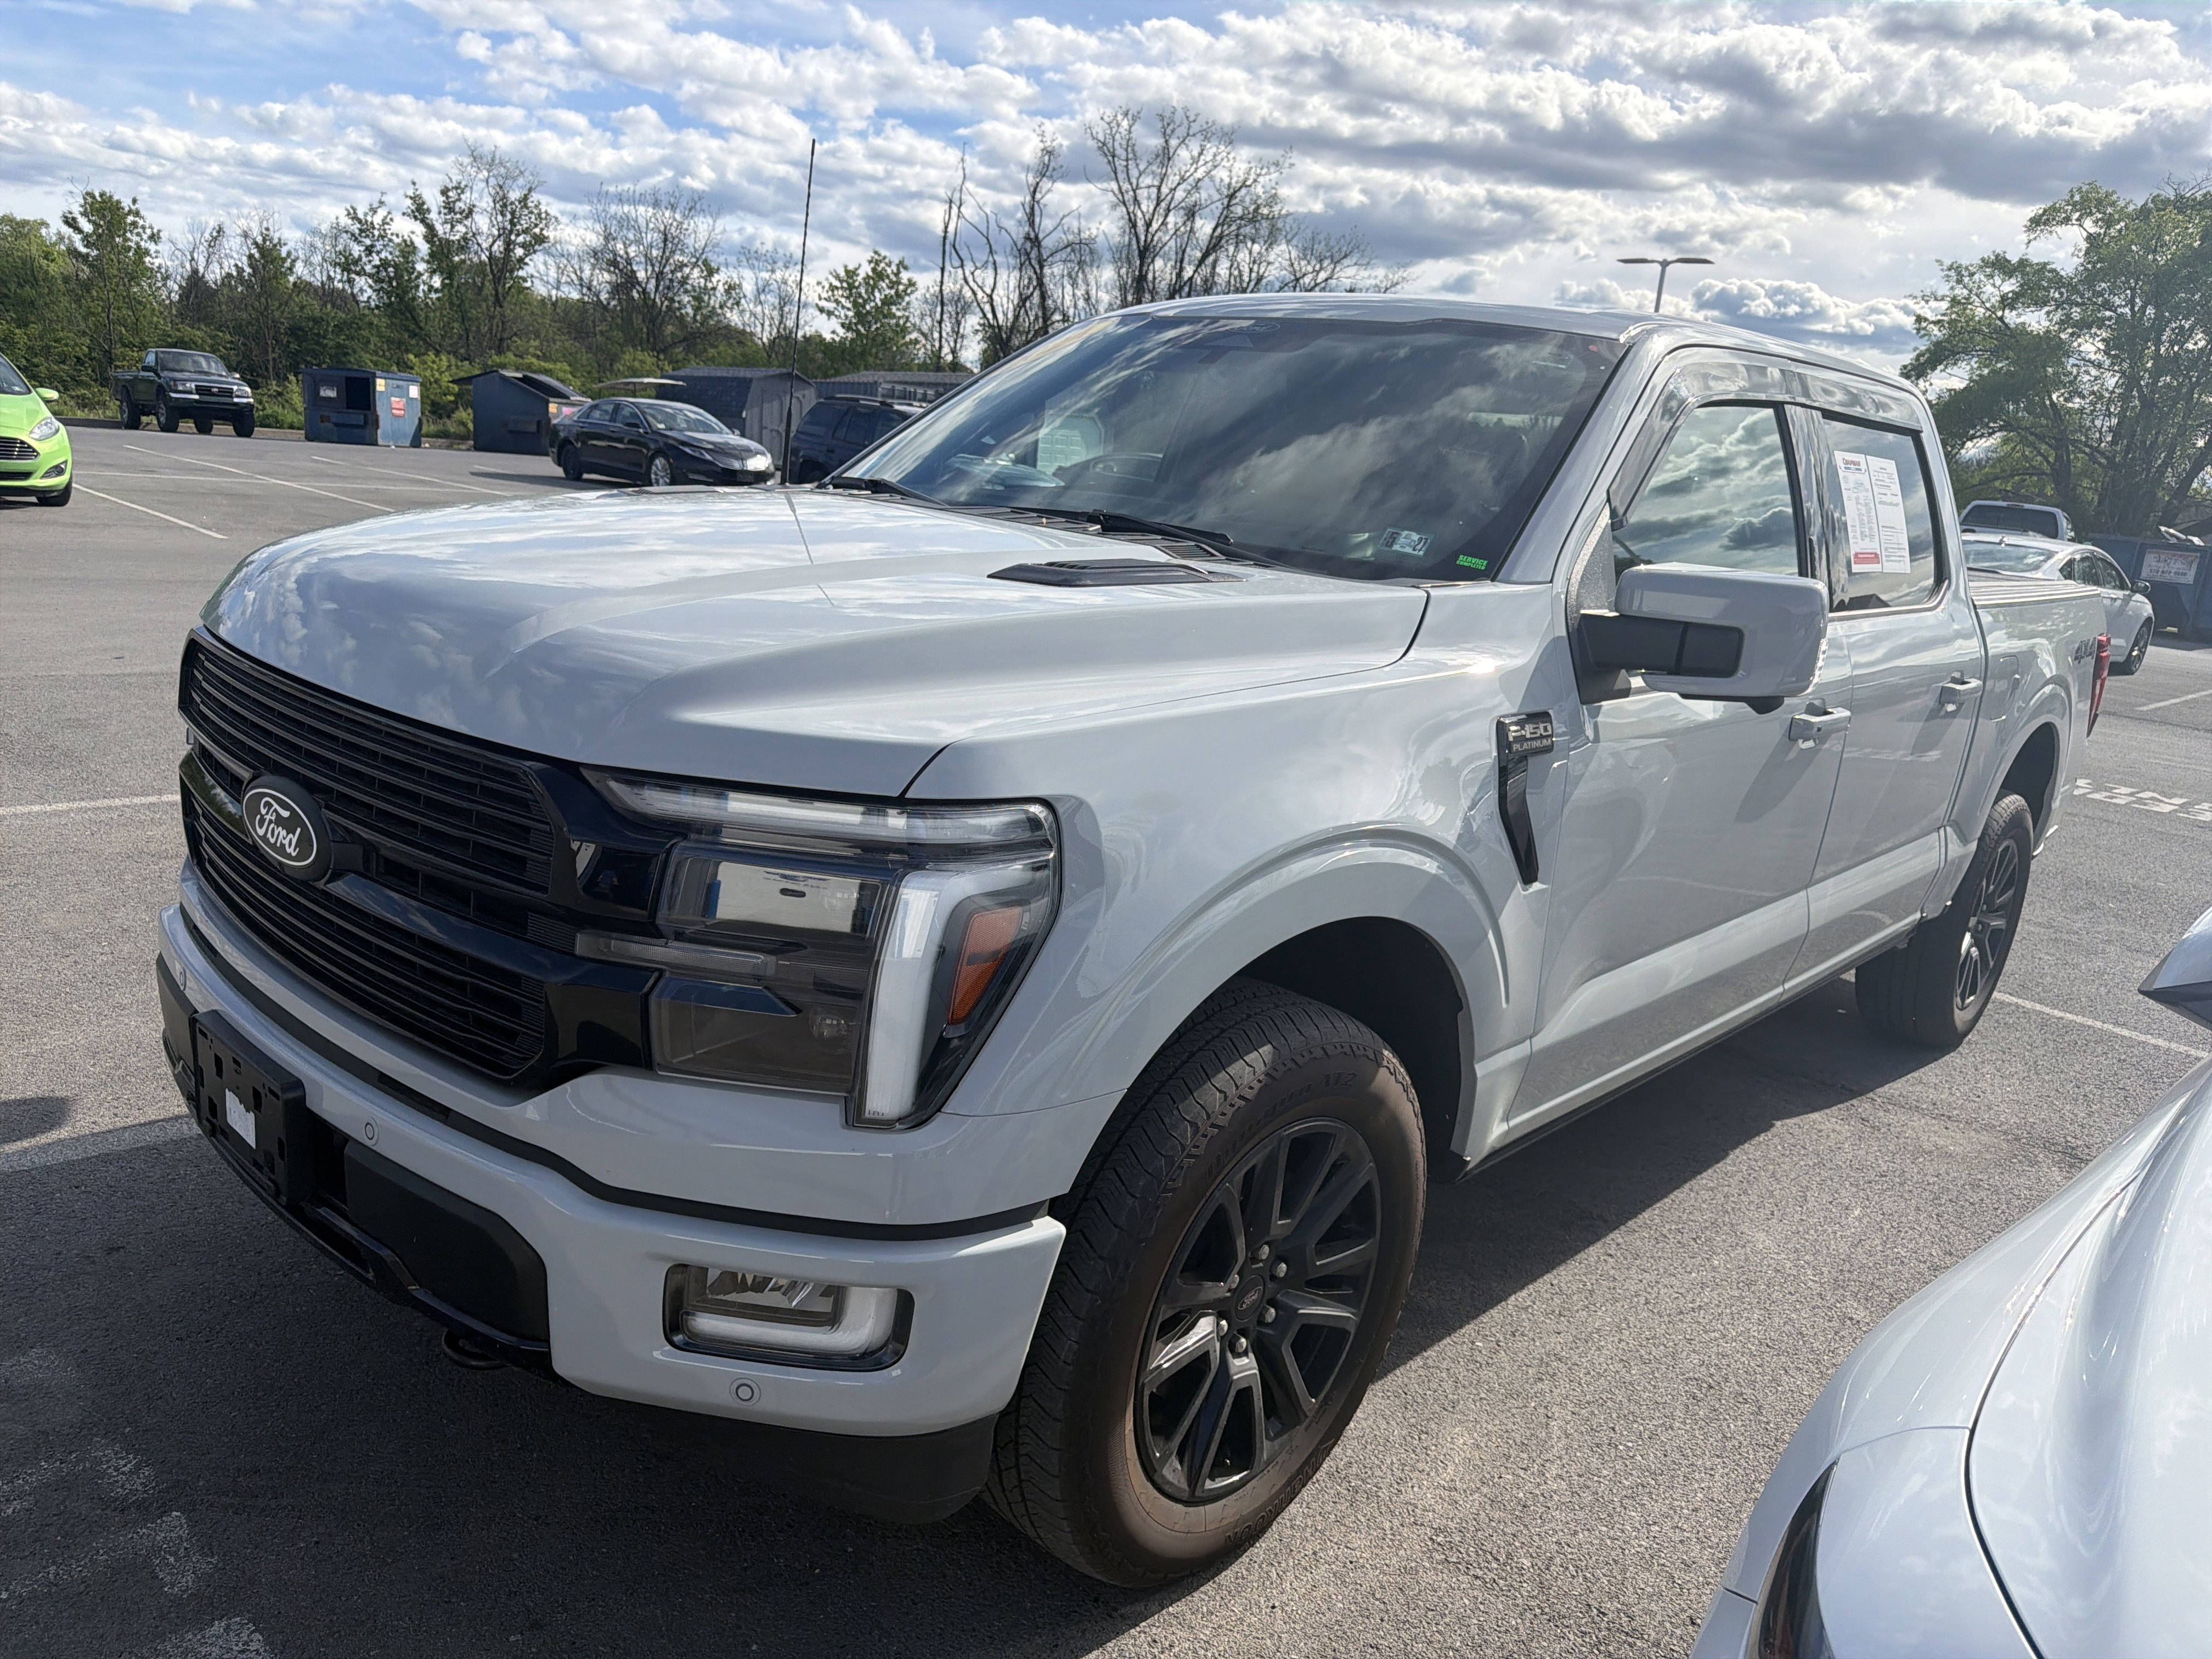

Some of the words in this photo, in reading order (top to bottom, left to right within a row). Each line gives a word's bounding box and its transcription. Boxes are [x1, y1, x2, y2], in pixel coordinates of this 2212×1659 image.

[1412, 537, 1429, 554] 27
[1458, 555, 1488, 566] SERVICE
[1506, 721, 1552, 742] F-150
[1513, 738, 1551, 752] PLATINUM
[255, 797, 301, 857] Ford
